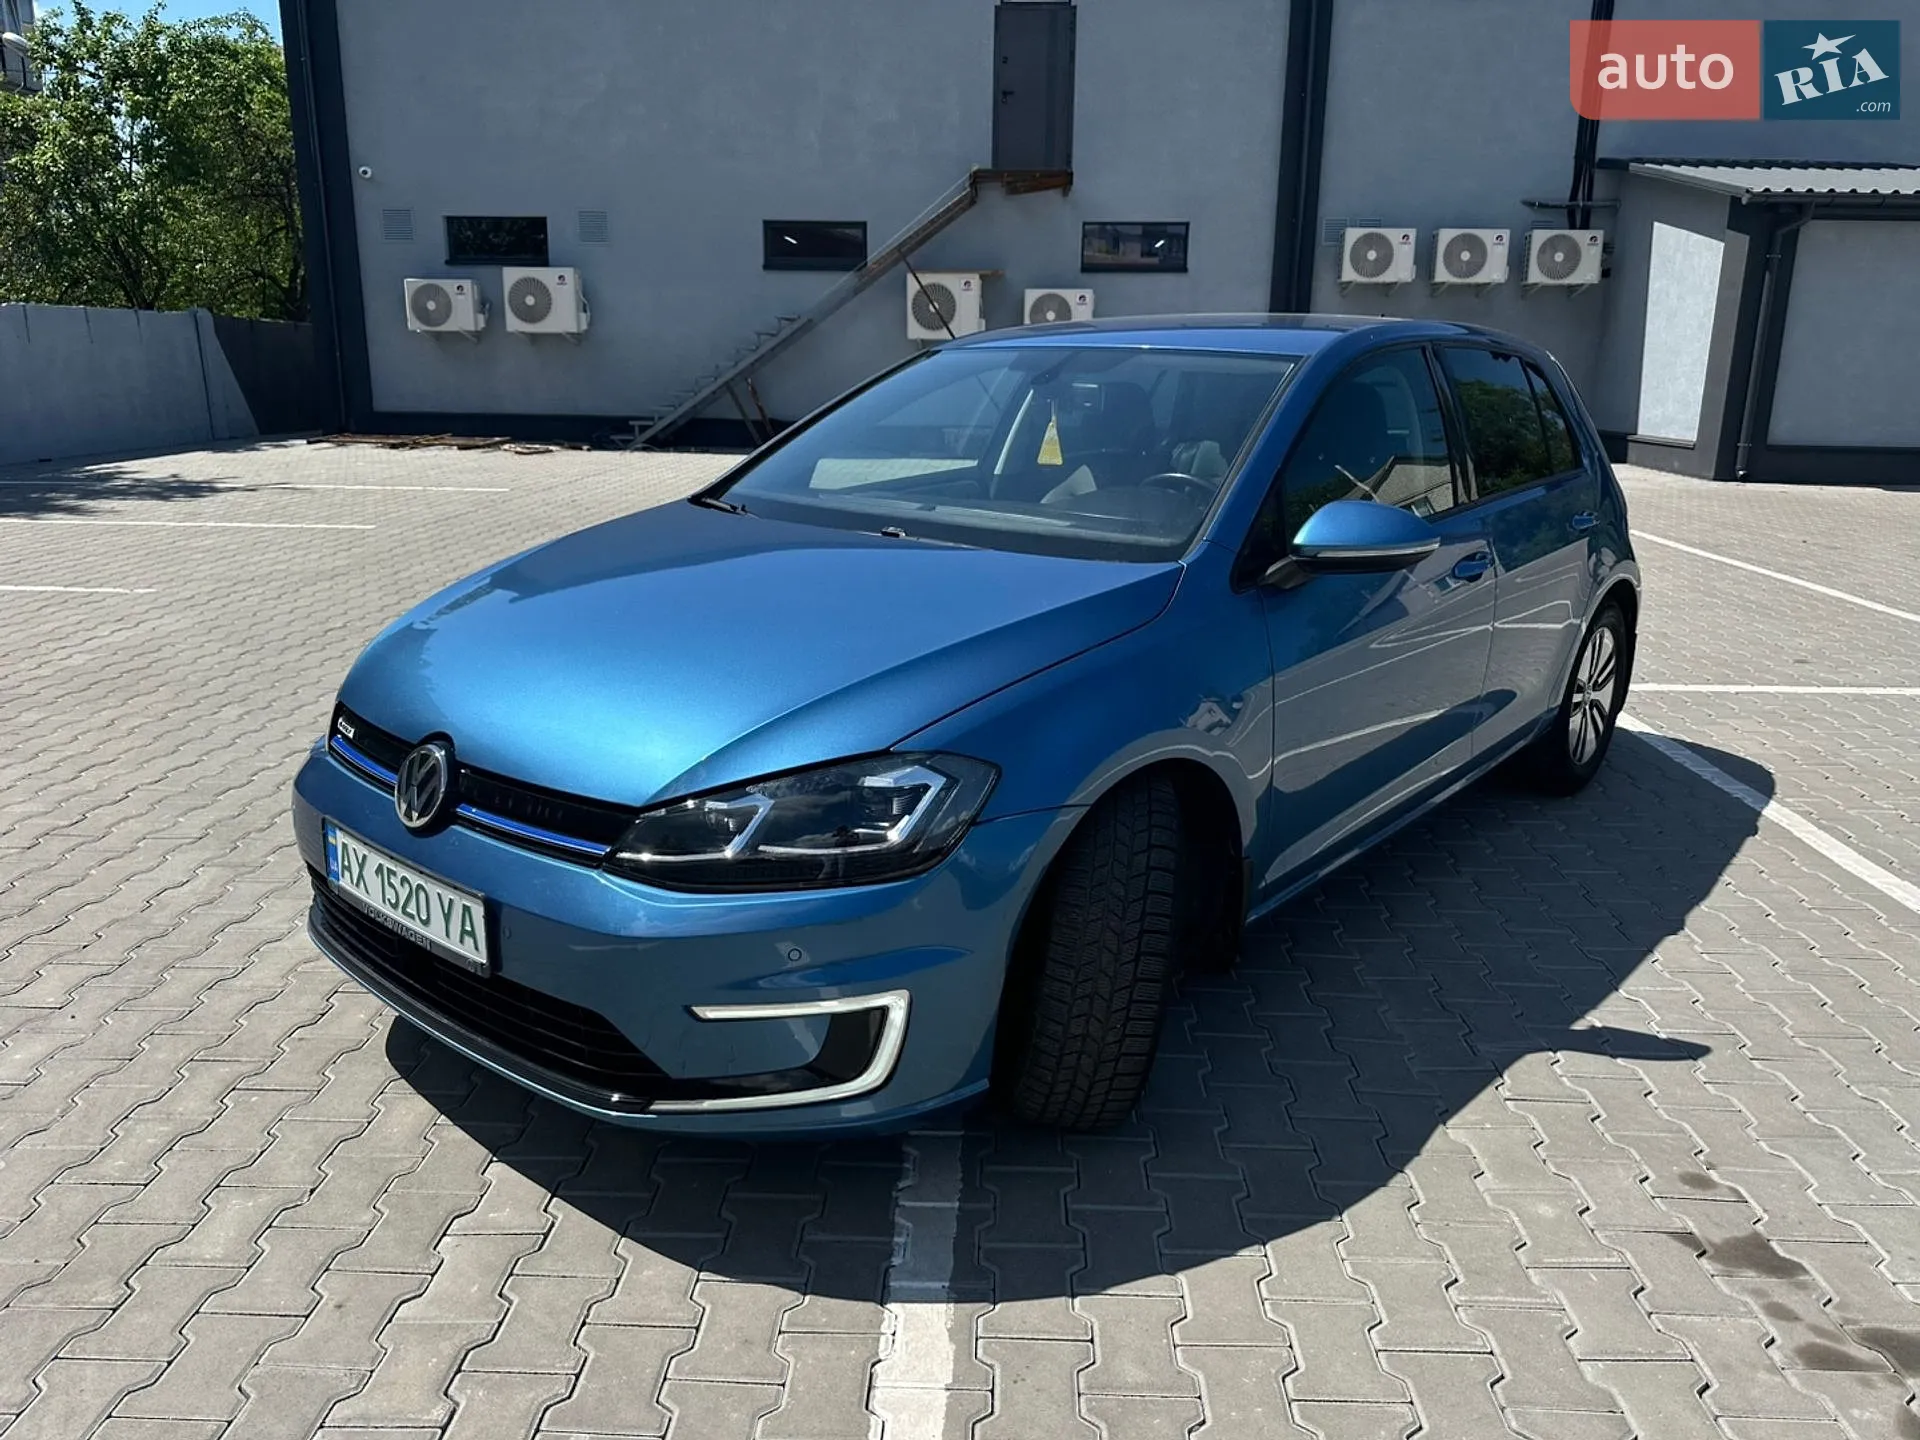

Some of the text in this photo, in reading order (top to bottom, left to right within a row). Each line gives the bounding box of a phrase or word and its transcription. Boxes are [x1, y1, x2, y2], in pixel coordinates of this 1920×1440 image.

[341, 841, 480, 952] AX 1520 YA
